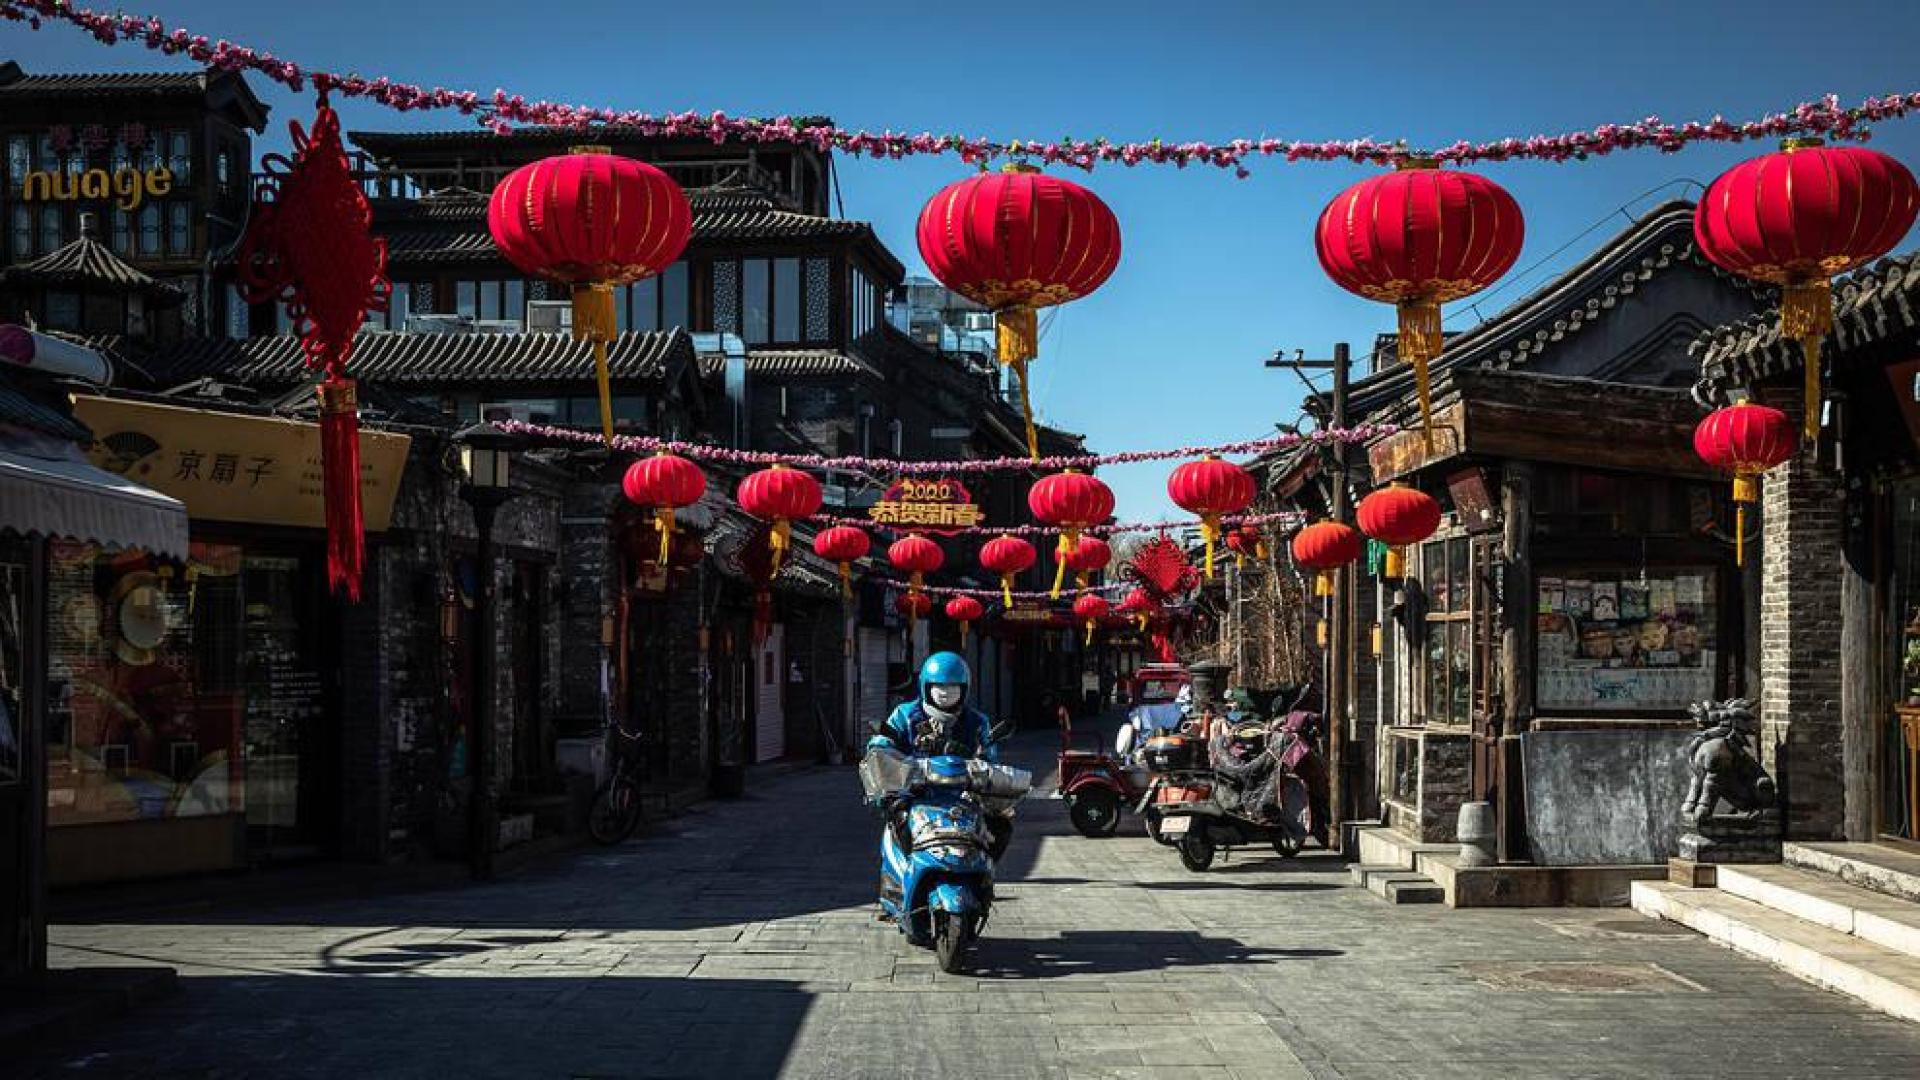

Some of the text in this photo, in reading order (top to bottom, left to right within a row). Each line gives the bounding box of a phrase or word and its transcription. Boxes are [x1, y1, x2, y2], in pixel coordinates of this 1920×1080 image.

[23, 165, 172, 211] nuage
[175, 449, 275, 486] 京扇子
[901, 478, 951, 501] 2020
